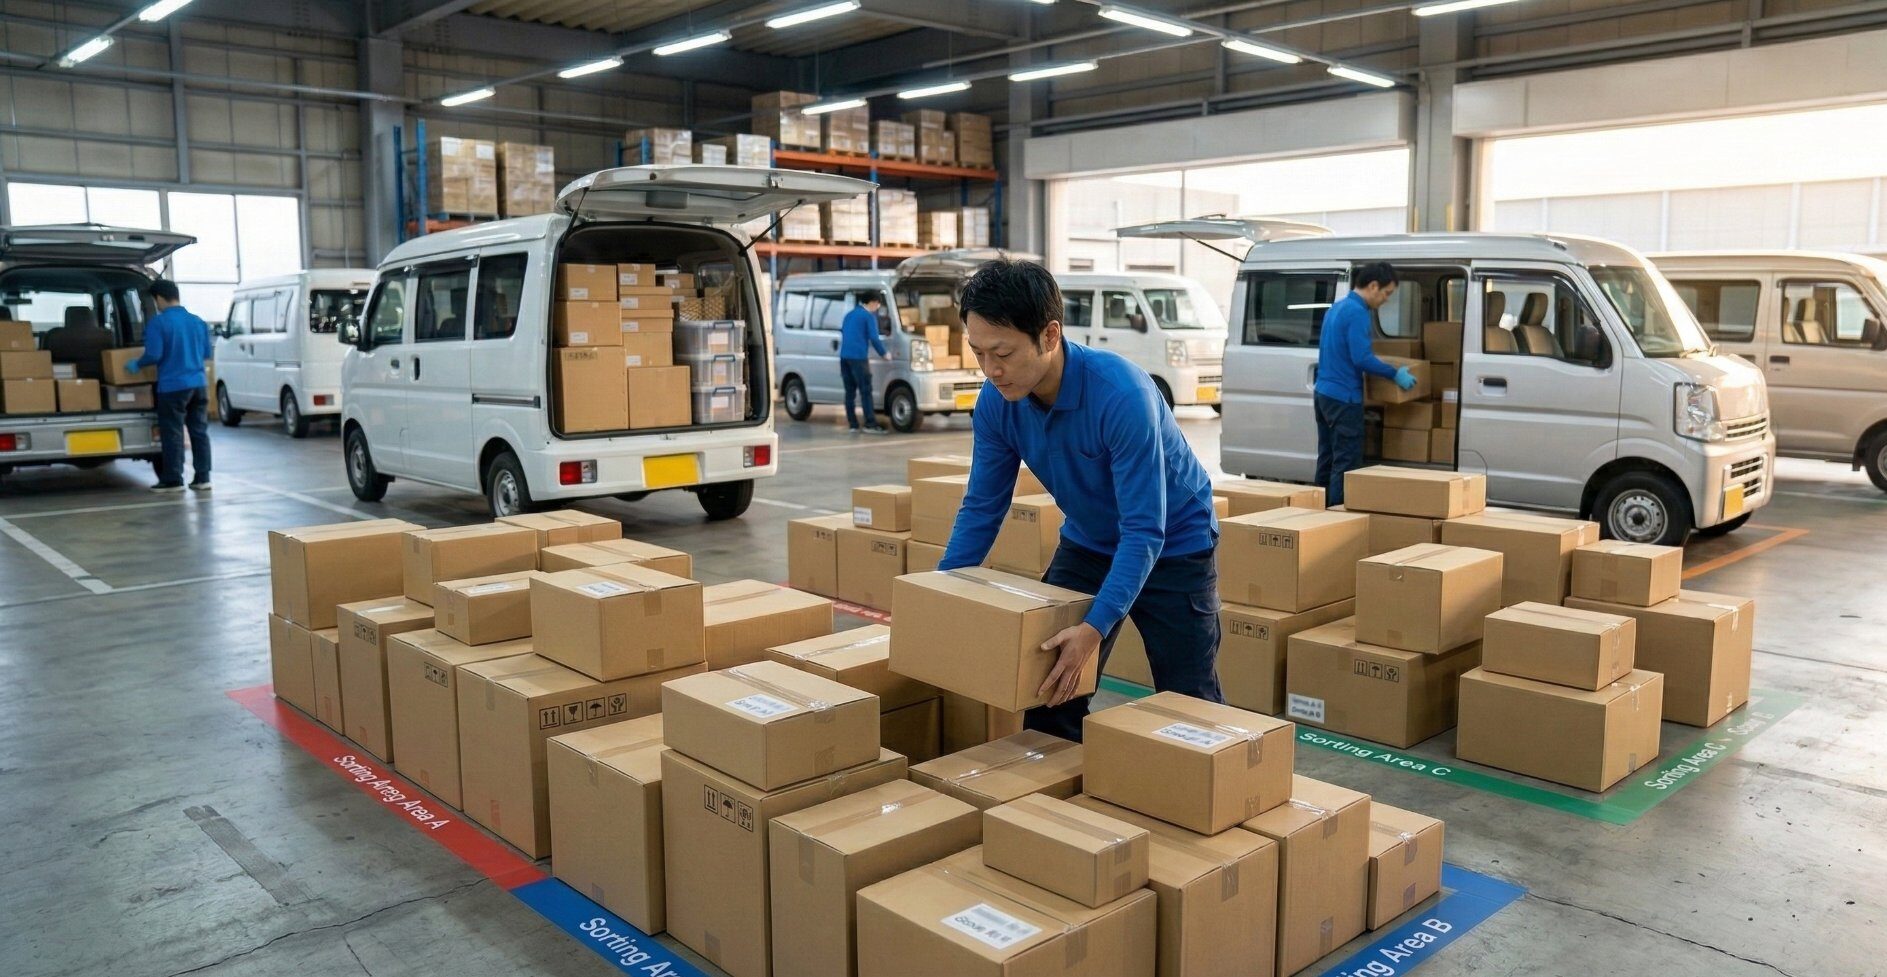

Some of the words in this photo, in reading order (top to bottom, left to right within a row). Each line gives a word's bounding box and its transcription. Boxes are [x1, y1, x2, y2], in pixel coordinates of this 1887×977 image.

[1299, 732, 1373, 758] Sorting
[1373, 753, 1426, 771] Area
[1431, 767, 1451, 776] C
[333, 755, 378, 782] Sorting
[395, 799, 435, 821] Area
[424, 819, 450, 830] A
[579, 917, 651, 966] Sorting
[1379, 931, 1438, 963] Area
[1421, 918, 1453, 934] B
